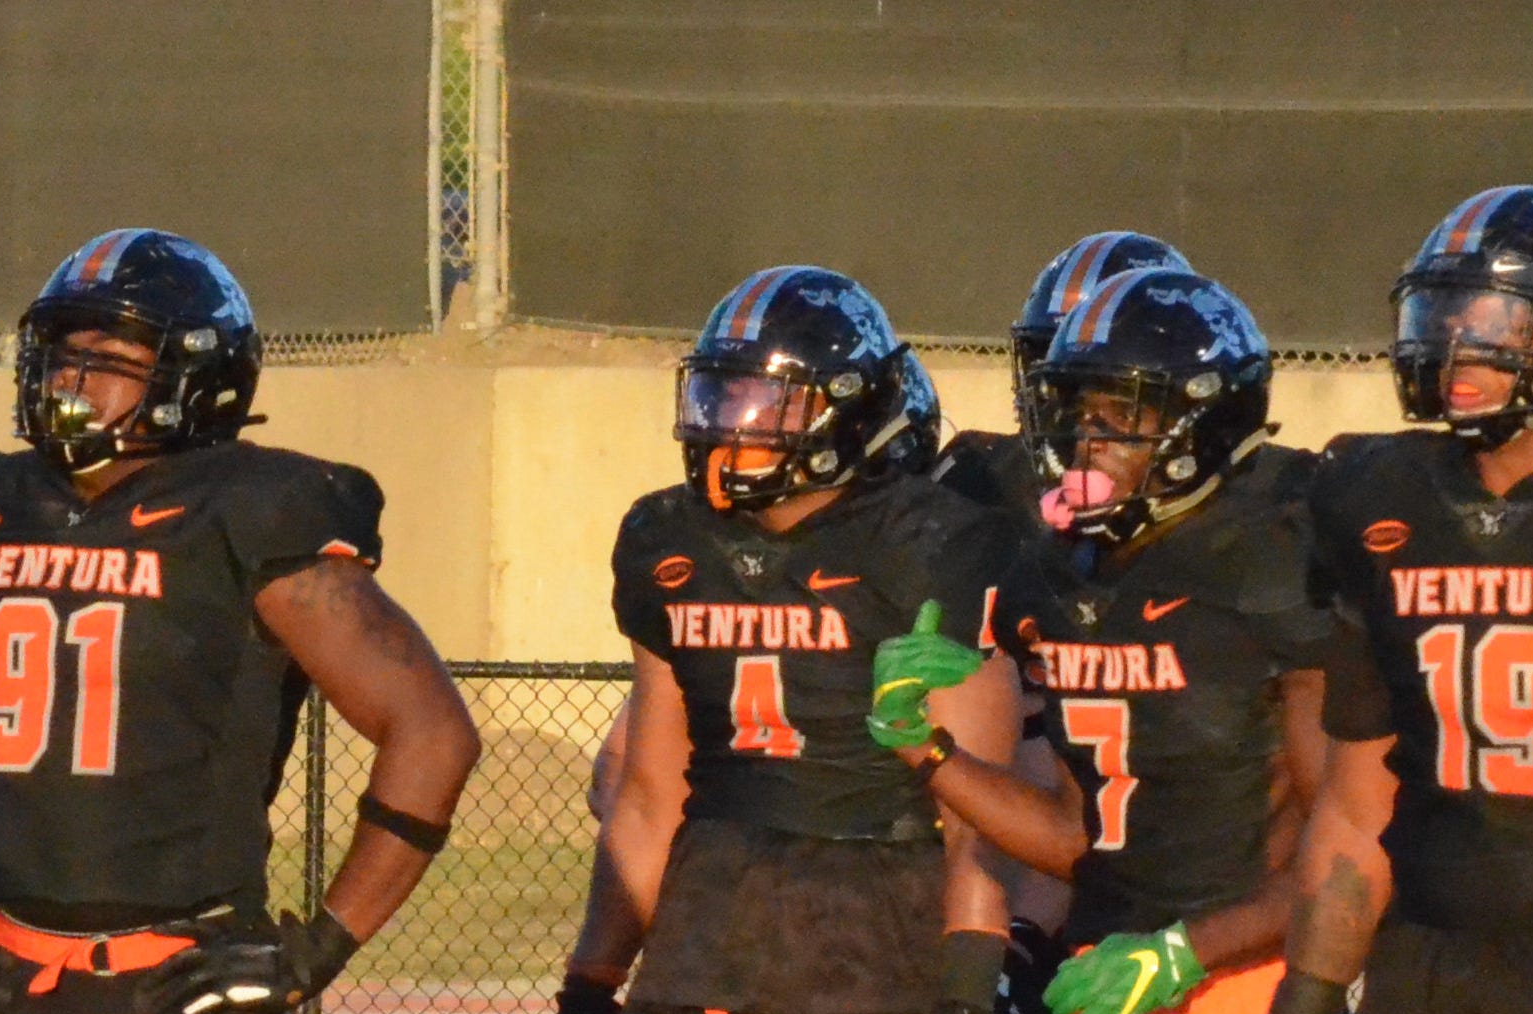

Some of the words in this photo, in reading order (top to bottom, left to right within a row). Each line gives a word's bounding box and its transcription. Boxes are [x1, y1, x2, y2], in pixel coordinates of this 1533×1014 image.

[665, 603, 851, 650] VENTURA
[1029, 642, 1187, 690] ENTURA
[729, 655, 806, 760] 4
[1061, 698, 1139, 851] 7
